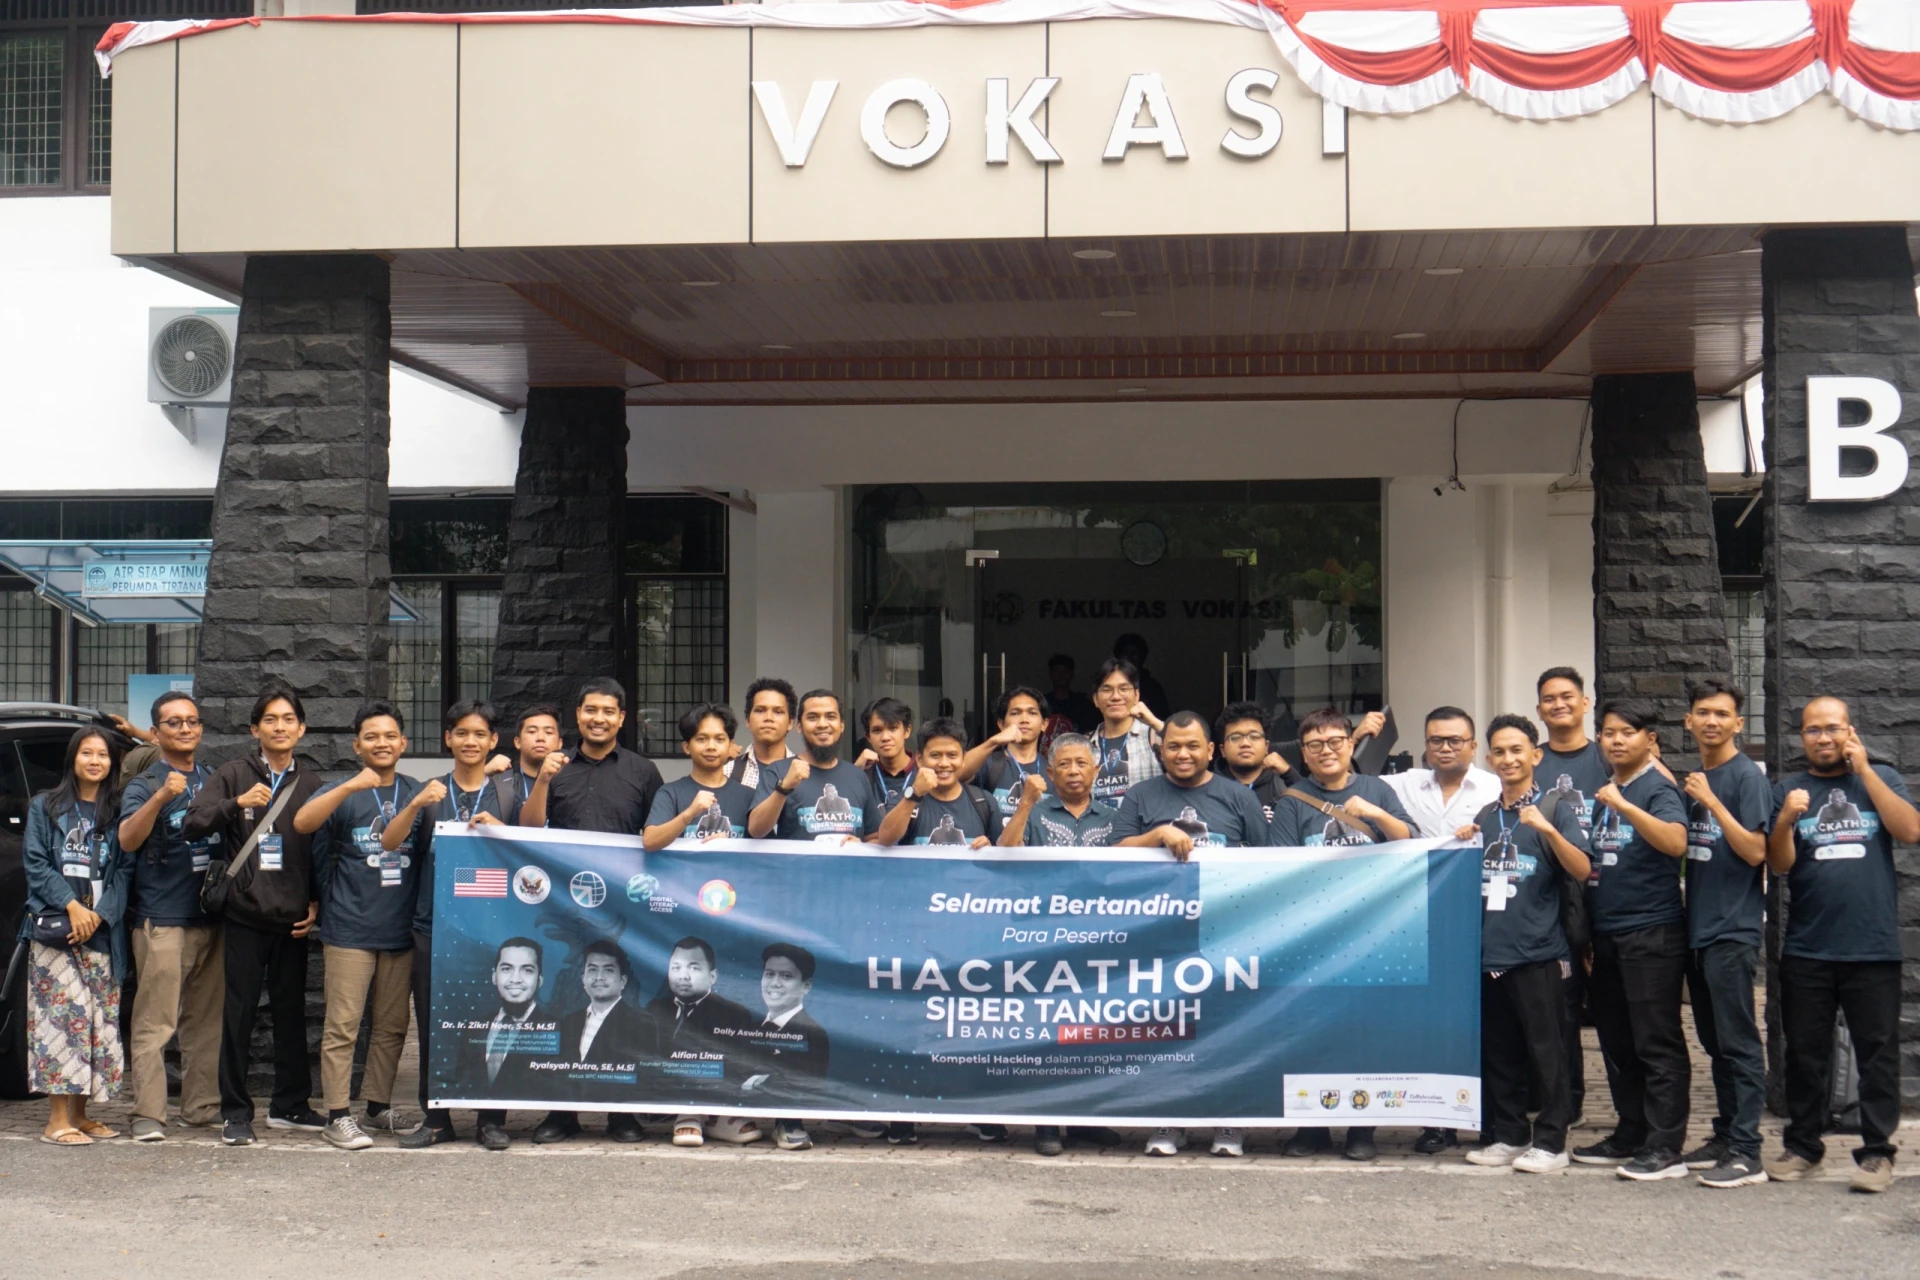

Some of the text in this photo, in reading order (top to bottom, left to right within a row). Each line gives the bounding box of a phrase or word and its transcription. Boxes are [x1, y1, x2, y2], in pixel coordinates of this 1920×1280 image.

[752, 67, 1345, 169] VOKASI
[1806, 375, 1909, 502] B
[113, 566, 134, 578] AIR
[138, 566, 166, 578] SIAP
[112, 581, 206, 592] PERUMDA TIRTANA
[1038, 599, 1166, 619] FAKULTAS
[800, 812, 862, 822] HACKATHON
[1800, 819, 1878, 835] HACKATHON
[928, 892, 1204, 920] Selamat Bertanding
[1002, 927, 1128, 944] Para Peserta
[868, 955, 1260, 994] HACKATHON
[926, 996, 1201, 1038] SIBER TANGGUH
[468, 1021, 489, 1029] Zikri
[491, 1022, 514, 1031] Noer,
[516, 1022, 534, 1031] S.Si,
[536, 1022, 556, 1030] M.Si
[960, 1025, 1174, 1040] BANGSA MERDEKA
[713, 1028, 803, 1041] Dolly Aswin Harahap
[670, 1051, 724, 1060] Alfian Linux
[931, 1052, 1195, 1066] Kompetisi Hacking dalam rangka menyambut
[572, 1063, 599, 1071] Putra,
[601, 1063, 614, 1072] SE,
[987, 1064, 1141, 1076] Hari Kemerdekaan RI ke-80
